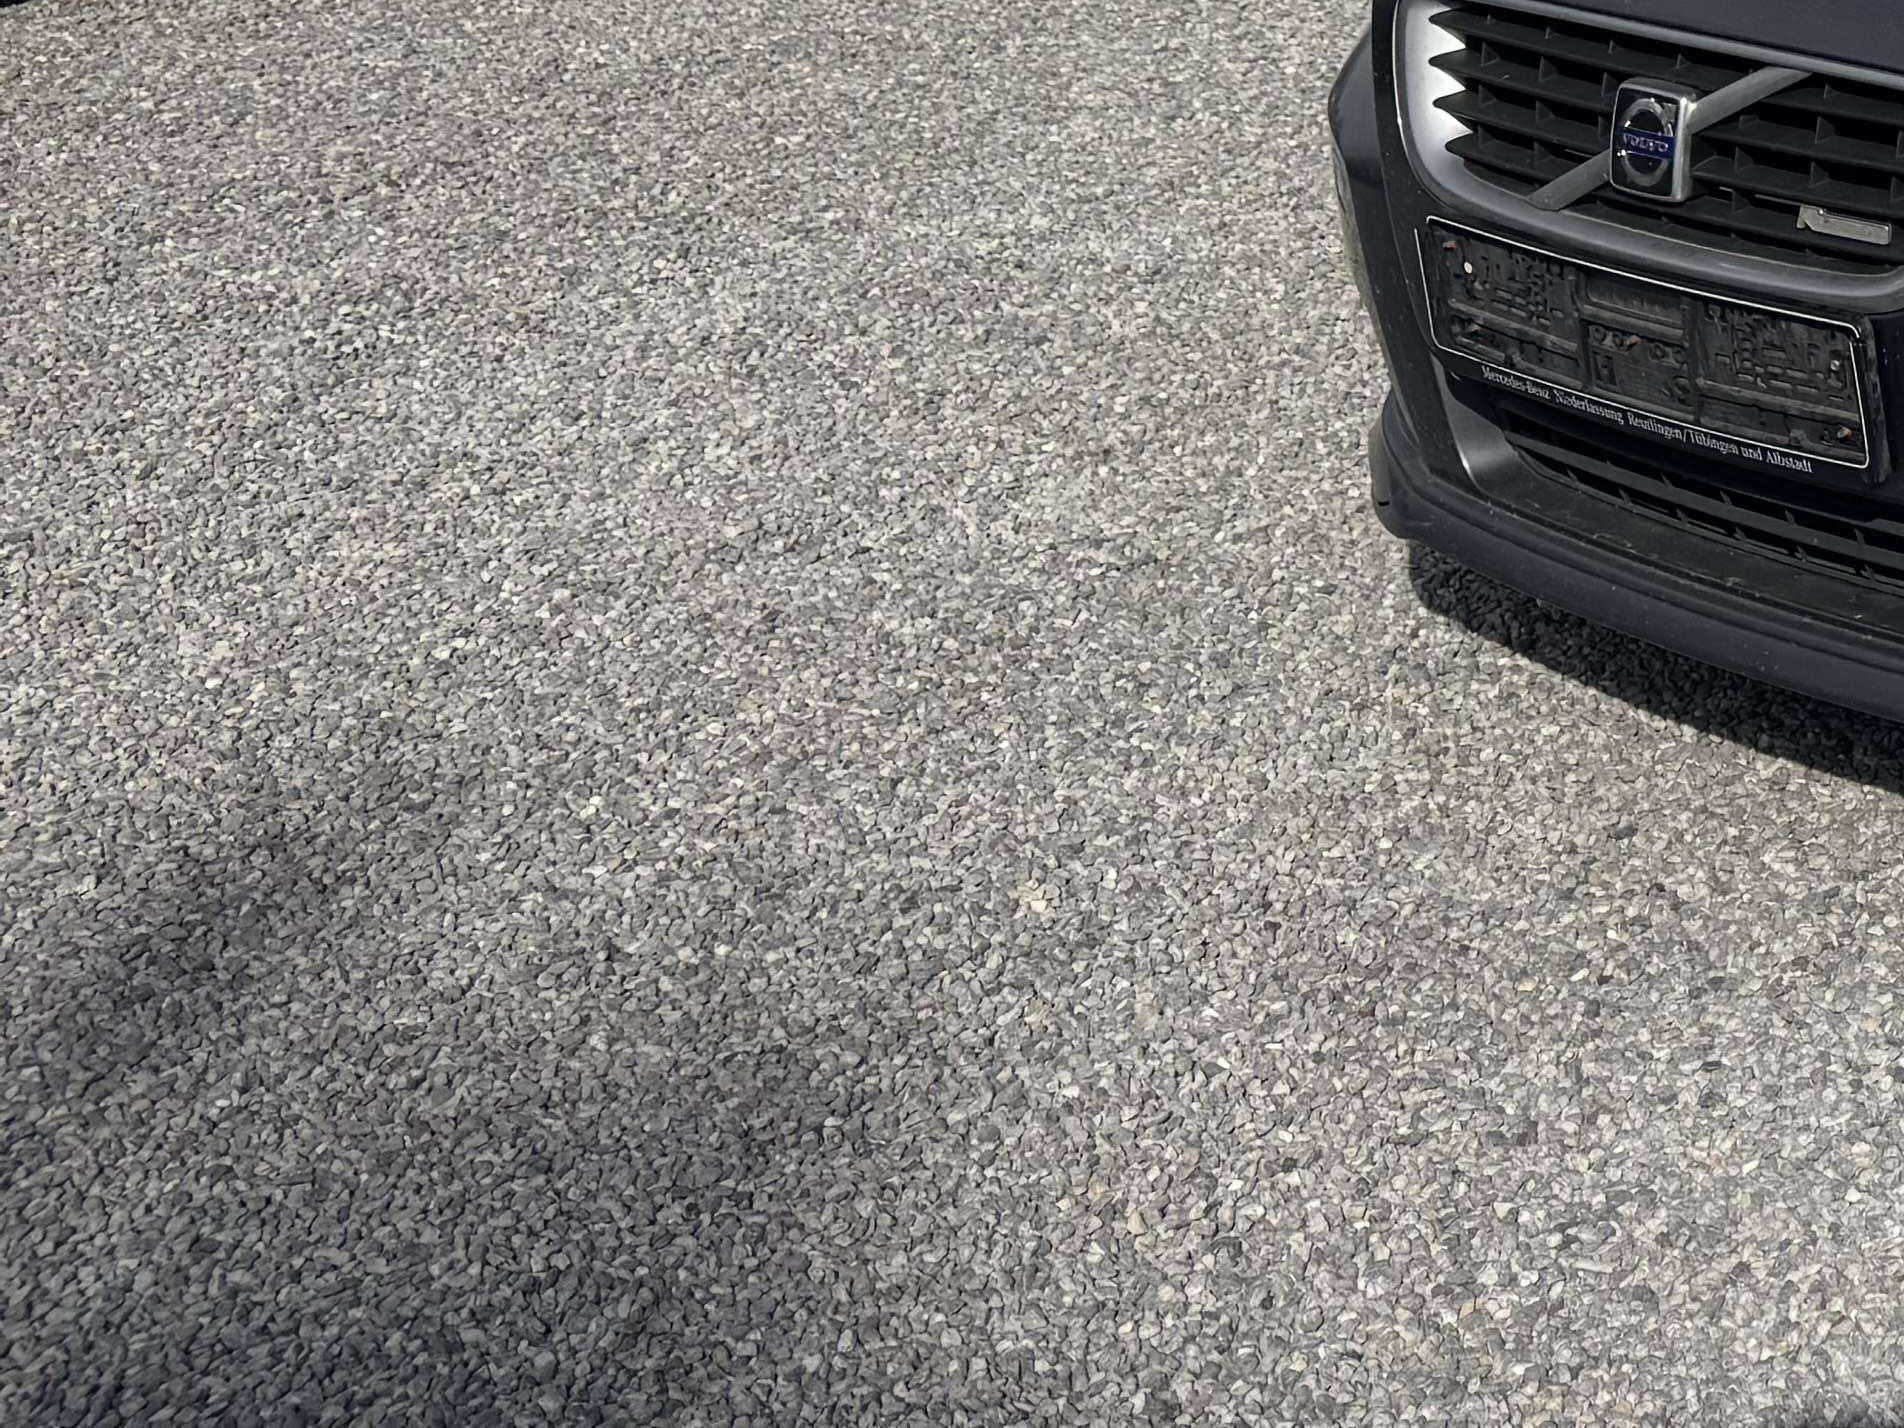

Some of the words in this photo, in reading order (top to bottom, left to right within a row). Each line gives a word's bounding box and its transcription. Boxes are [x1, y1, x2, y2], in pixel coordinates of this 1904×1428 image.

[1623, 132, 1669, 153] VOLVO
[1482, 365, 1551, 400] Mercedes-Benz
[1555, 390, 1624, 425] Niederlassung
[1741, 444, 1763, 461] und
[1766, 446, 1814, 474] Albstadt
